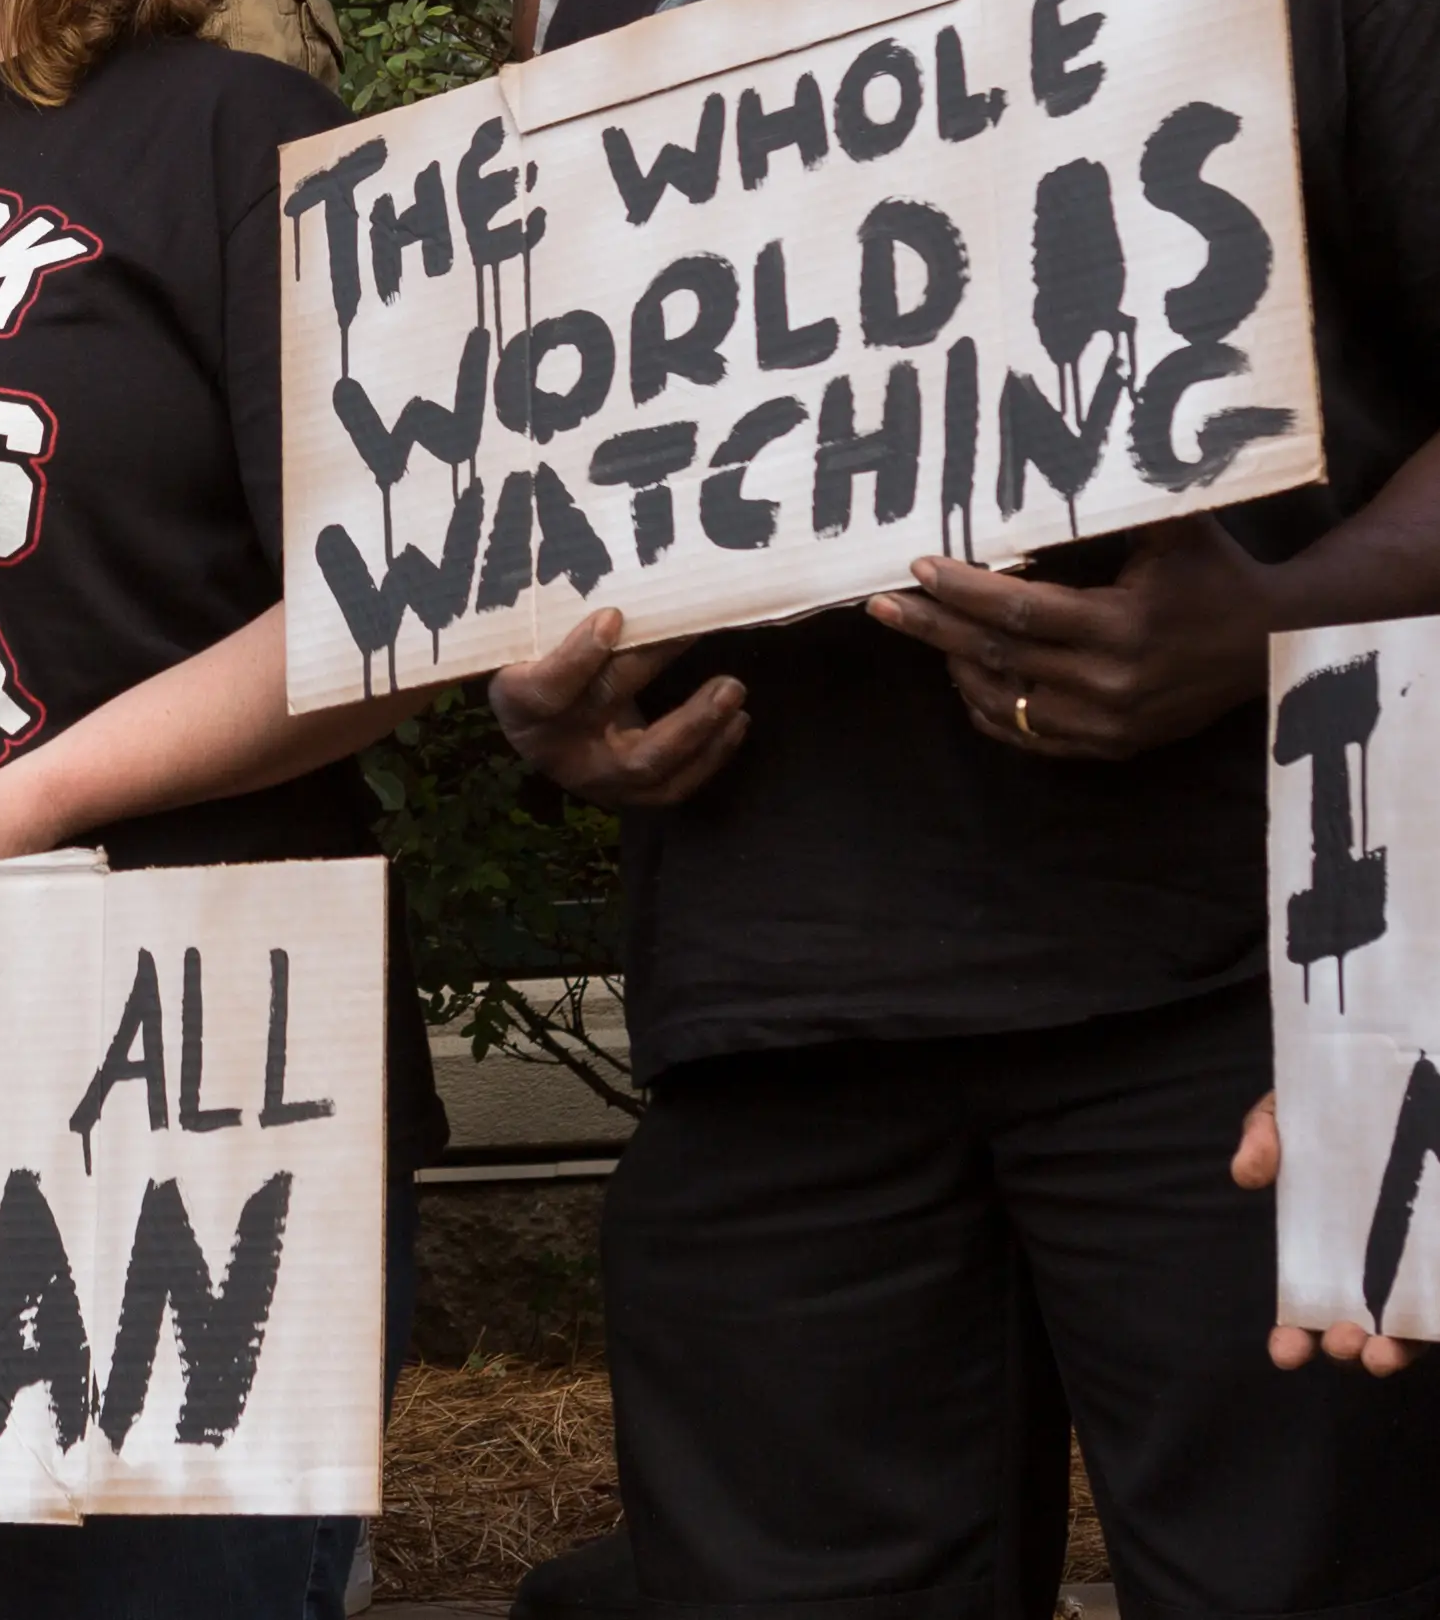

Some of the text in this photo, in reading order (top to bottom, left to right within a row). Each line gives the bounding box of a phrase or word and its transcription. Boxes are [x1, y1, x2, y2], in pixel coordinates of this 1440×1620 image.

[284, 116, 546, 330] THE
[333, 100, 1273, 488] WORLD IS
[316, 336, 1296, 655] WATCHING
[1272, 650, 1388, 970] I
[69, 946, 336, 1145] ALL
